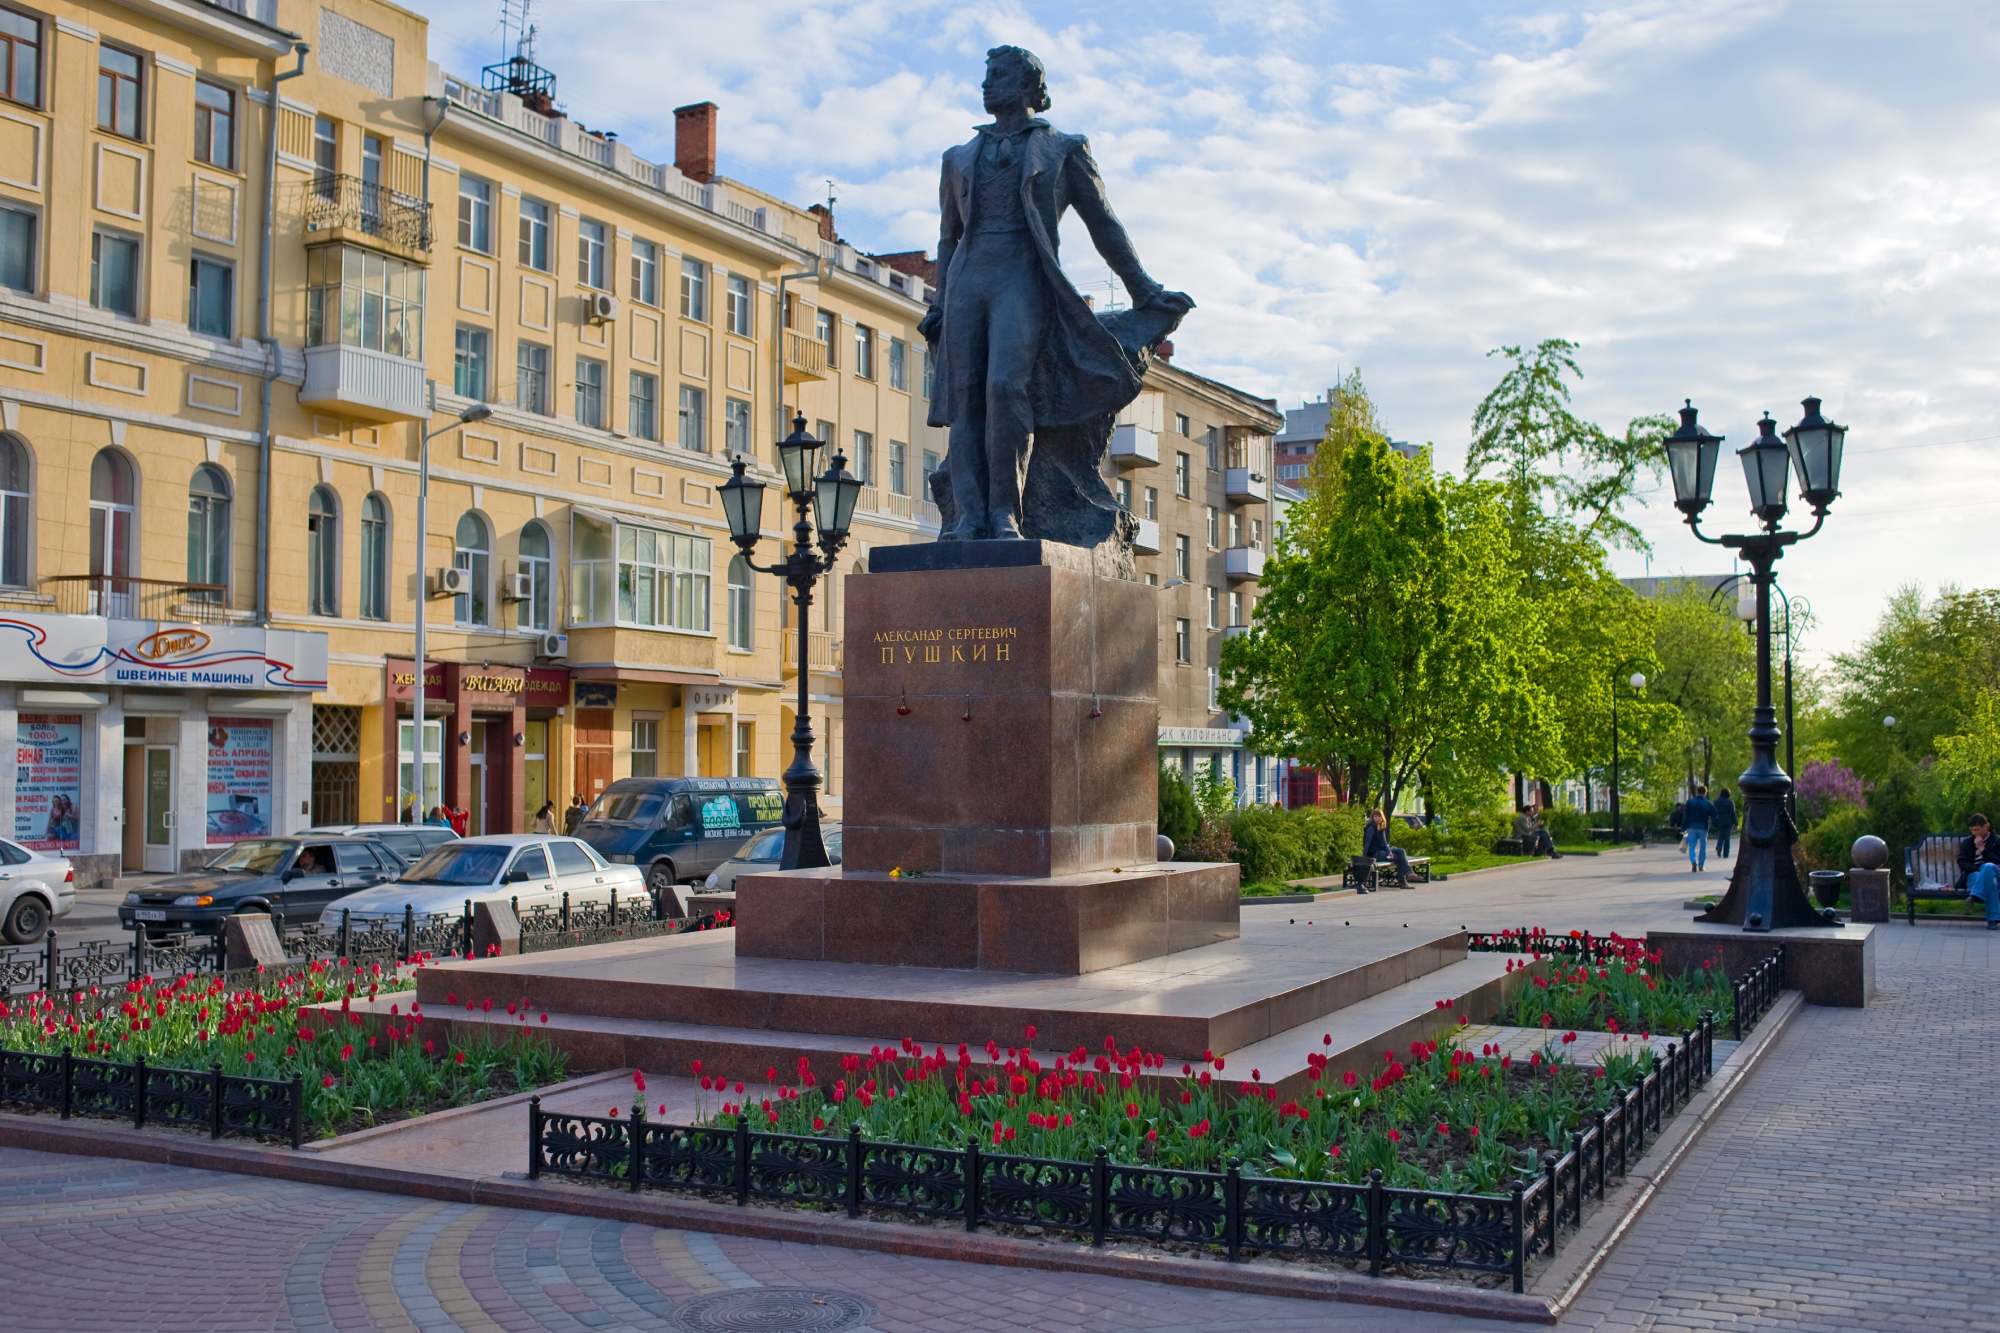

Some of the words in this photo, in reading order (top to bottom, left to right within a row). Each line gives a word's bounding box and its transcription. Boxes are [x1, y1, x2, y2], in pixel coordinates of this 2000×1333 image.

[873, 630, 944, 642] АЛЕКСАНДР
[948, 627, 1017, 640] СЕРГЕЕВИЧ
[881, 643, 1010, 664] ПУШКИН
[116, 669, 188, 681] ШВЕЙНЫЕ
[191, 671, 254, 684] МАШИНЫ
[394, 672, 442, 685] ЖЕНКАЯ
[524, 681, 561, 692] ОДЕЖДА
[694, 691, 734, 705] ОБУВЬ
[232, 749, 271, 757] АПРЕЛЬ
